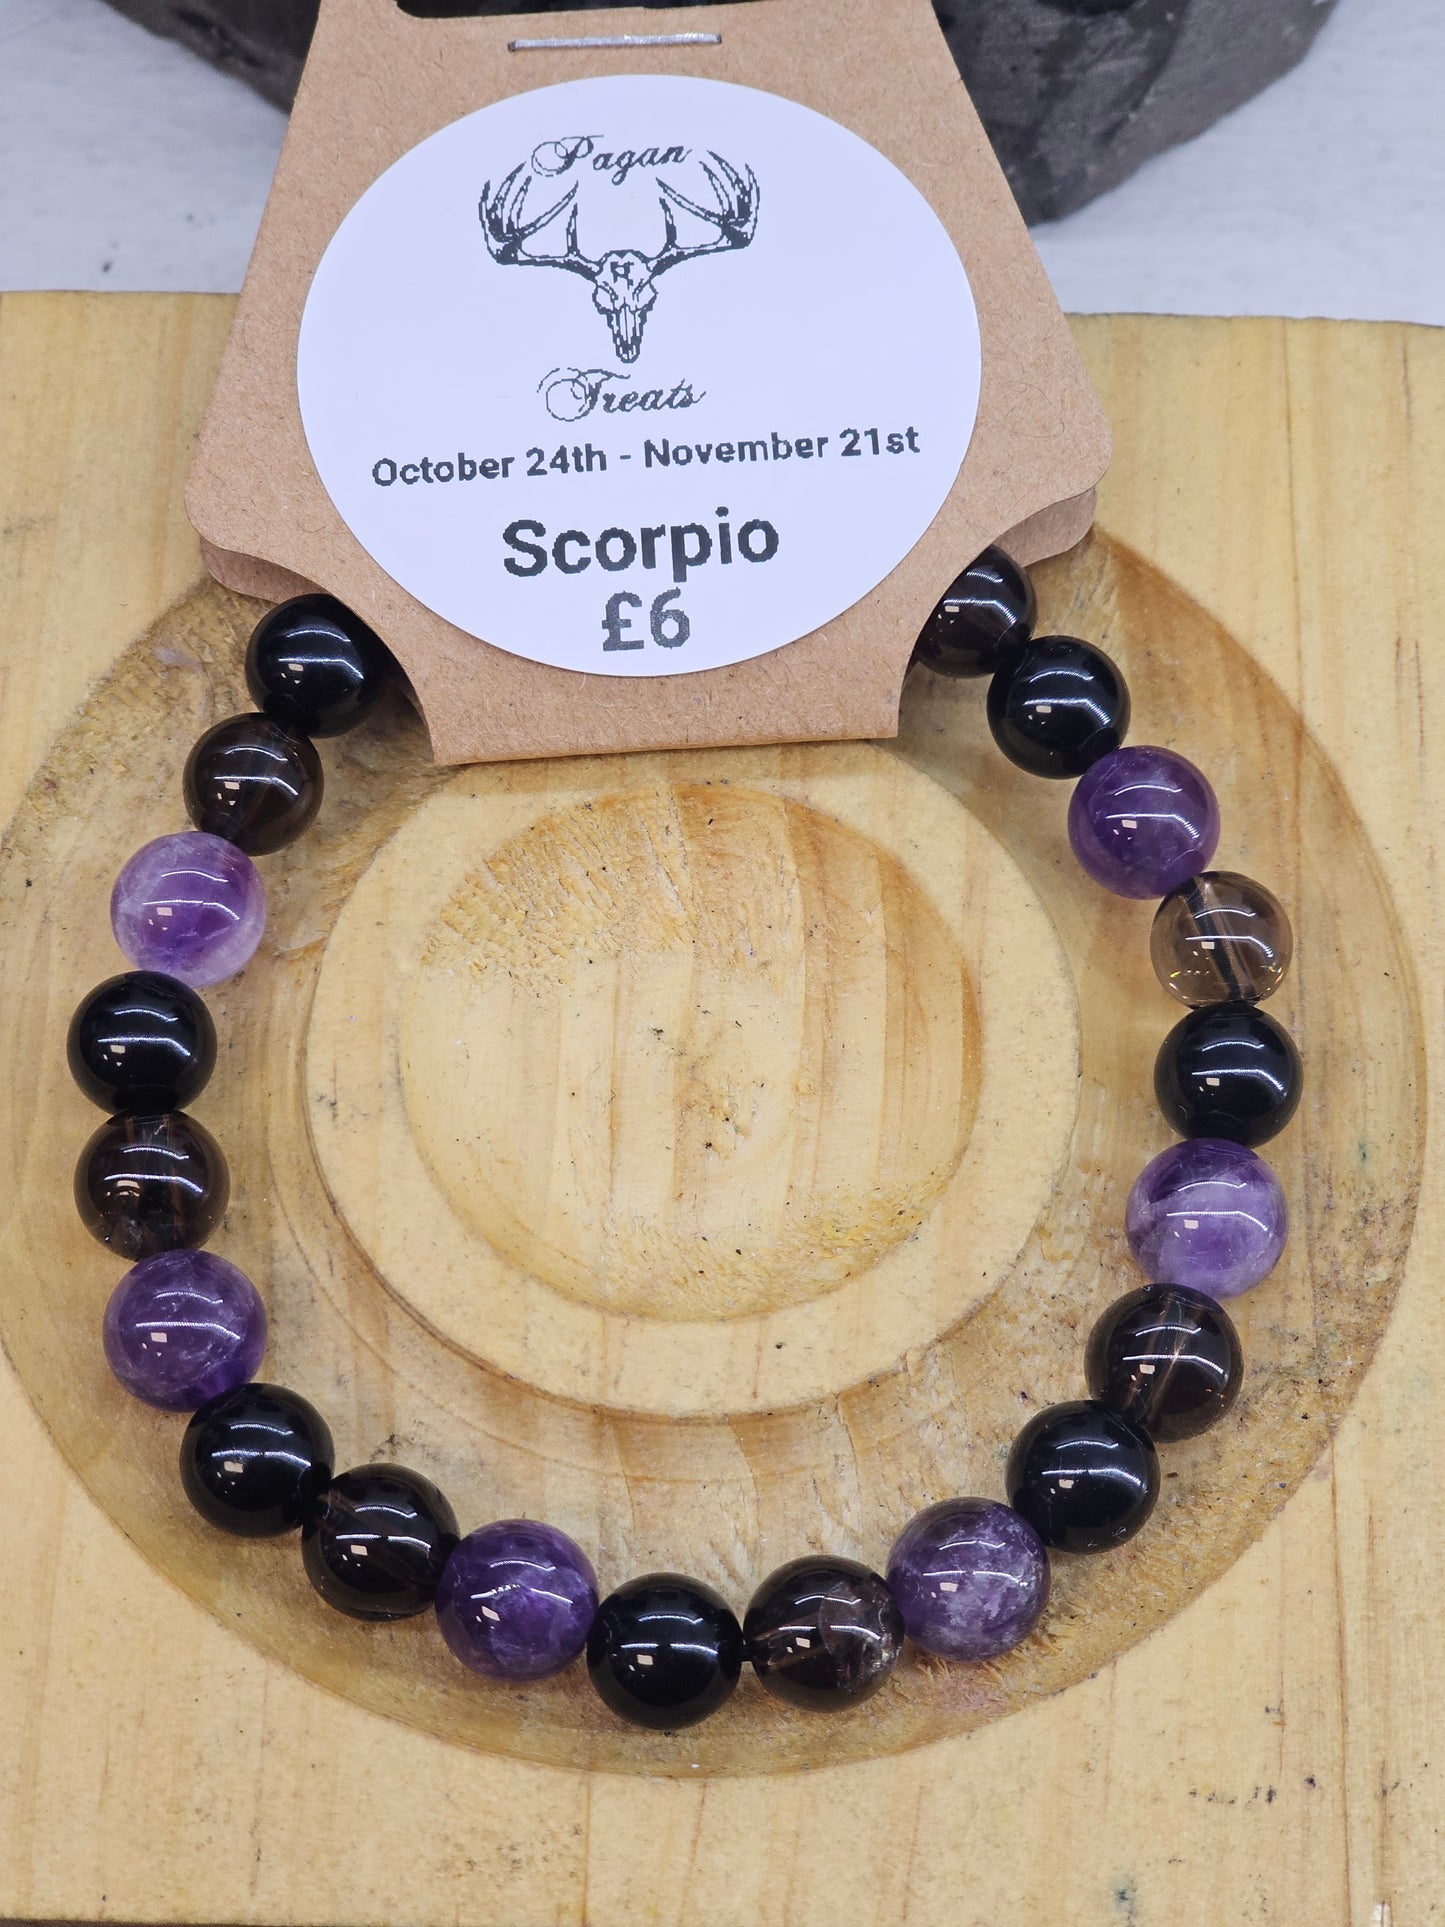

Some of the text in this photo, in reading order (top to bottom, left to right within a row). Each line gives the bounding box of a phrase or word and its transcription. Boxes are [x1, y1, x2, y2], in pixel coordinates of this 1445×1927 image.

[531, 134, 693, 186] Pagan
[536, 366, 707, 422] Treats
[371, 452, 515, 487] October
[525, 443, 608, 477] 24th
[643, 430, 829, 469] November
[839, 426, 921, 457] 21st
[502, 506, 780, 583] Scorpio
[601, 586, 691, 652] £6
